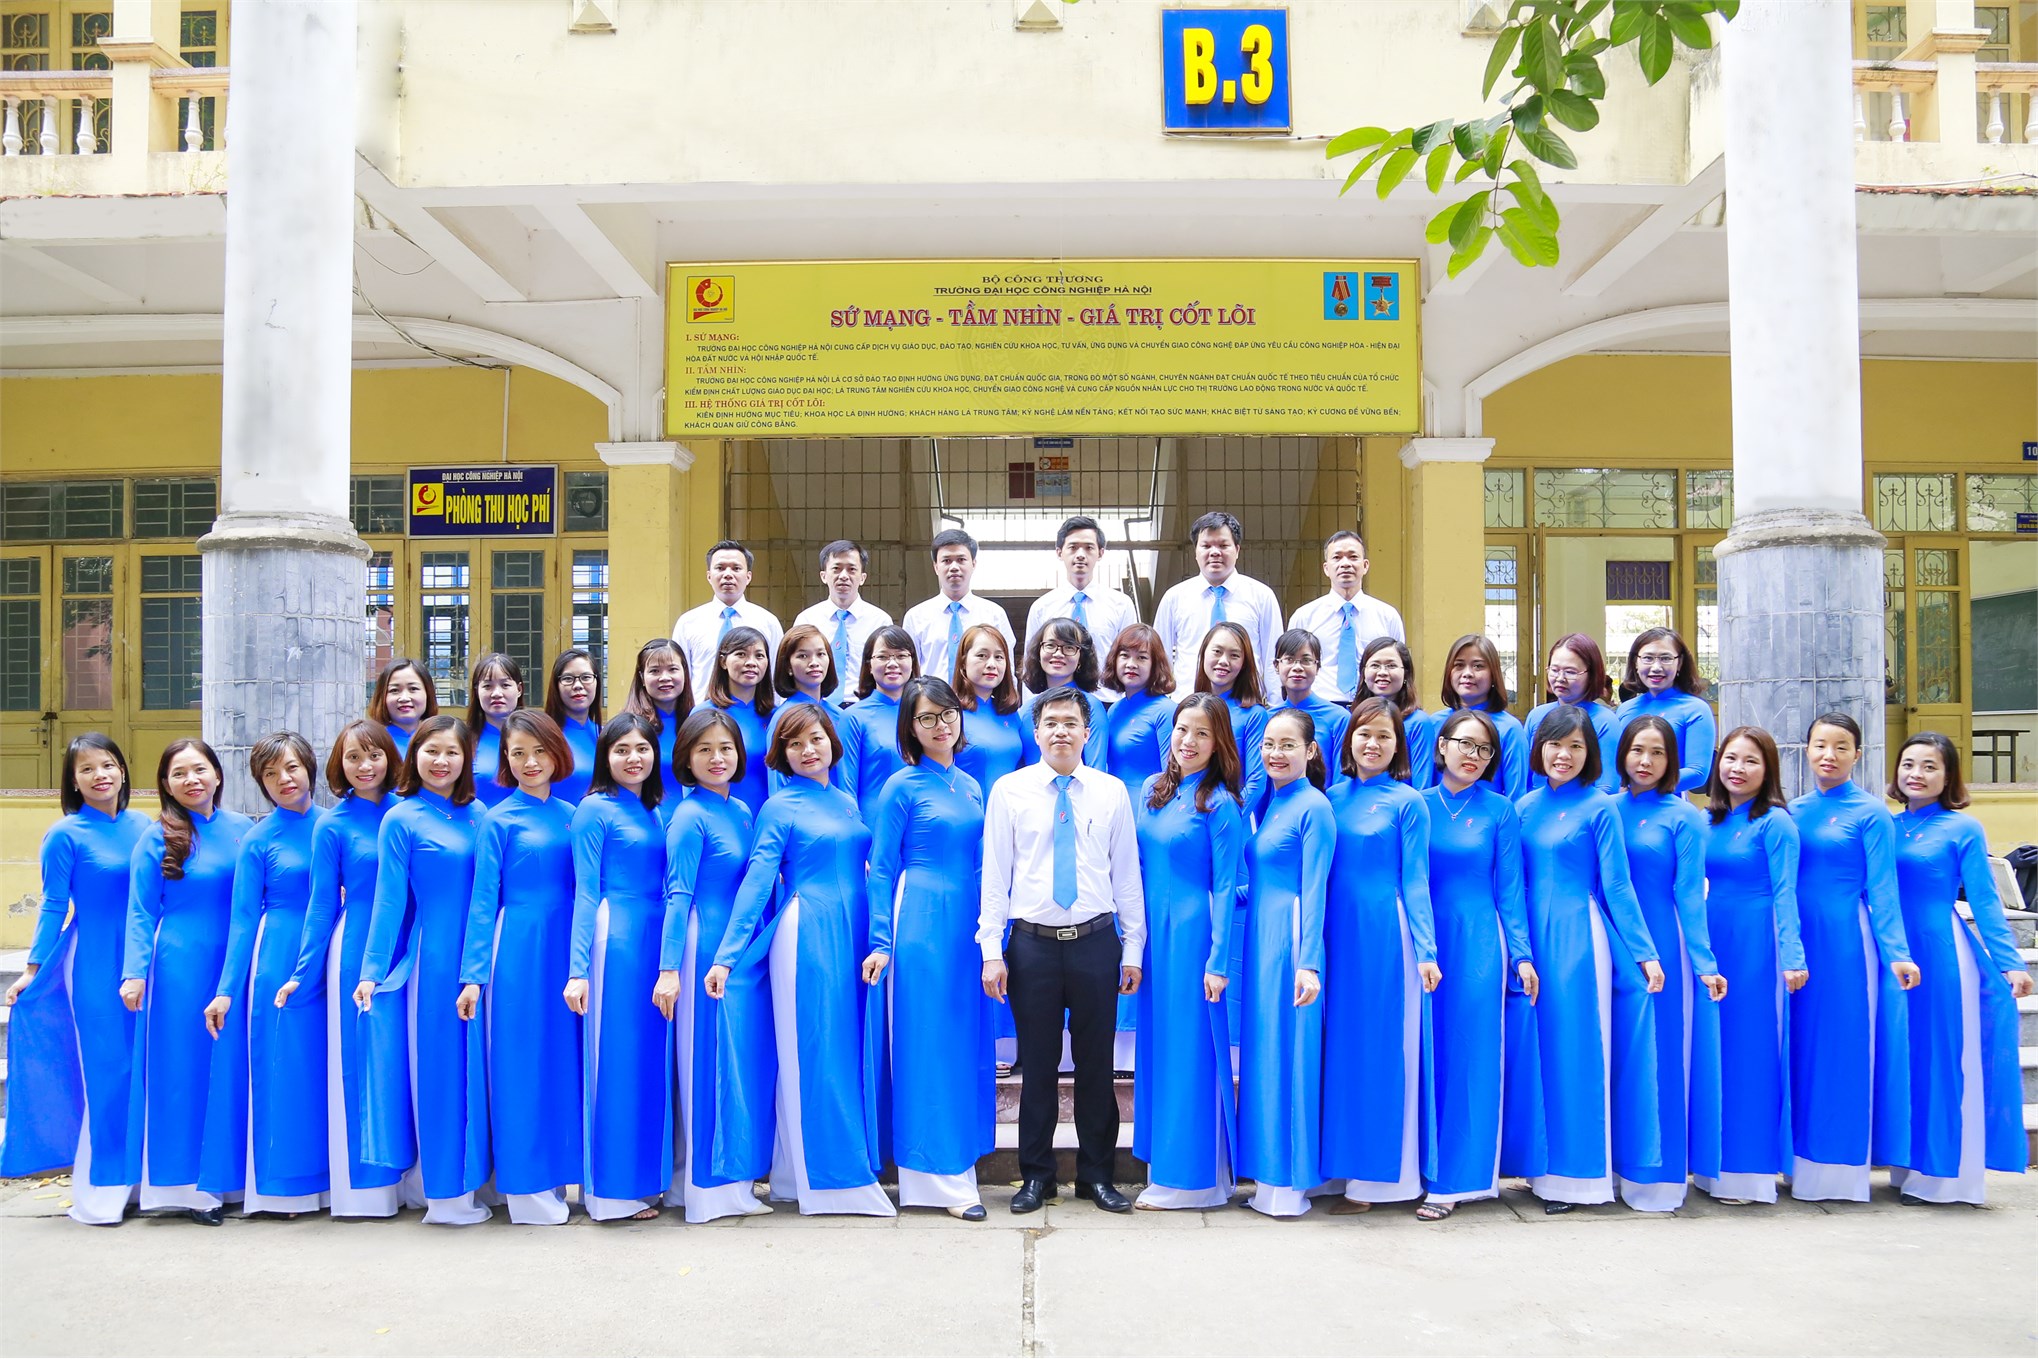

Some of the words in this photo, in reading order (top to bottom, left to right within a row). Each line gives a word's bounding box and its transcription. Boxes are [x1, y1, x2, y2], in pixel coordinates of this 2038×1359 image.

[1183, 24, 1273, 104] B.3
[982, 274, 1001, 285] BỘ
[1004, 274, 1042, 283] CÔNG
[1046, 274, 1103, 283] THƯƠNG
[983, 287, 1003, 295] ĐẠI
[1006, 287, 1030, 295] HỌC
[1033, 285, 1066, 293] CÔNG
[1069, 285, 1111, 295] NGHIỆP
[1114, 283, 1130, 293] HÀ
[1133, 284, 1152, 295] NỘI
[830, 305, 861, 329] SỨ
[863, 309, 932, 331] MẠNG
[948, 300, 998, 327] TẦM
[1002, 304, 1062, 326] NHÌN
[1079, 303, 1121, 326] GIÁ
[1125, 308, 1164, 331] TRỊ
[1169, 300, 1213, 326] CỐT
[1217, 304, 1256, 326] LÕI
[694, 332, 707, 341] SỨ
[708, 333, 739, 342] MẠNG:
[685, 401, 698, 409] III.
[700, 399, 713, 410] HỆ
[715, 398, 747, 408] THỐNG
[749, 398, 766, 408] GIÁ
[768, 400, 784, 409] TRỊ
[786, 398, 805, 407] CỐT
[807, 398, 825, 407] LÕI:
[446, 488, 482, 524] PHÒNG
[484, 494, 505, 524] THU
[507, 494, 529, 530] HỌC
[532, 488, 550, 523] PHÍ
